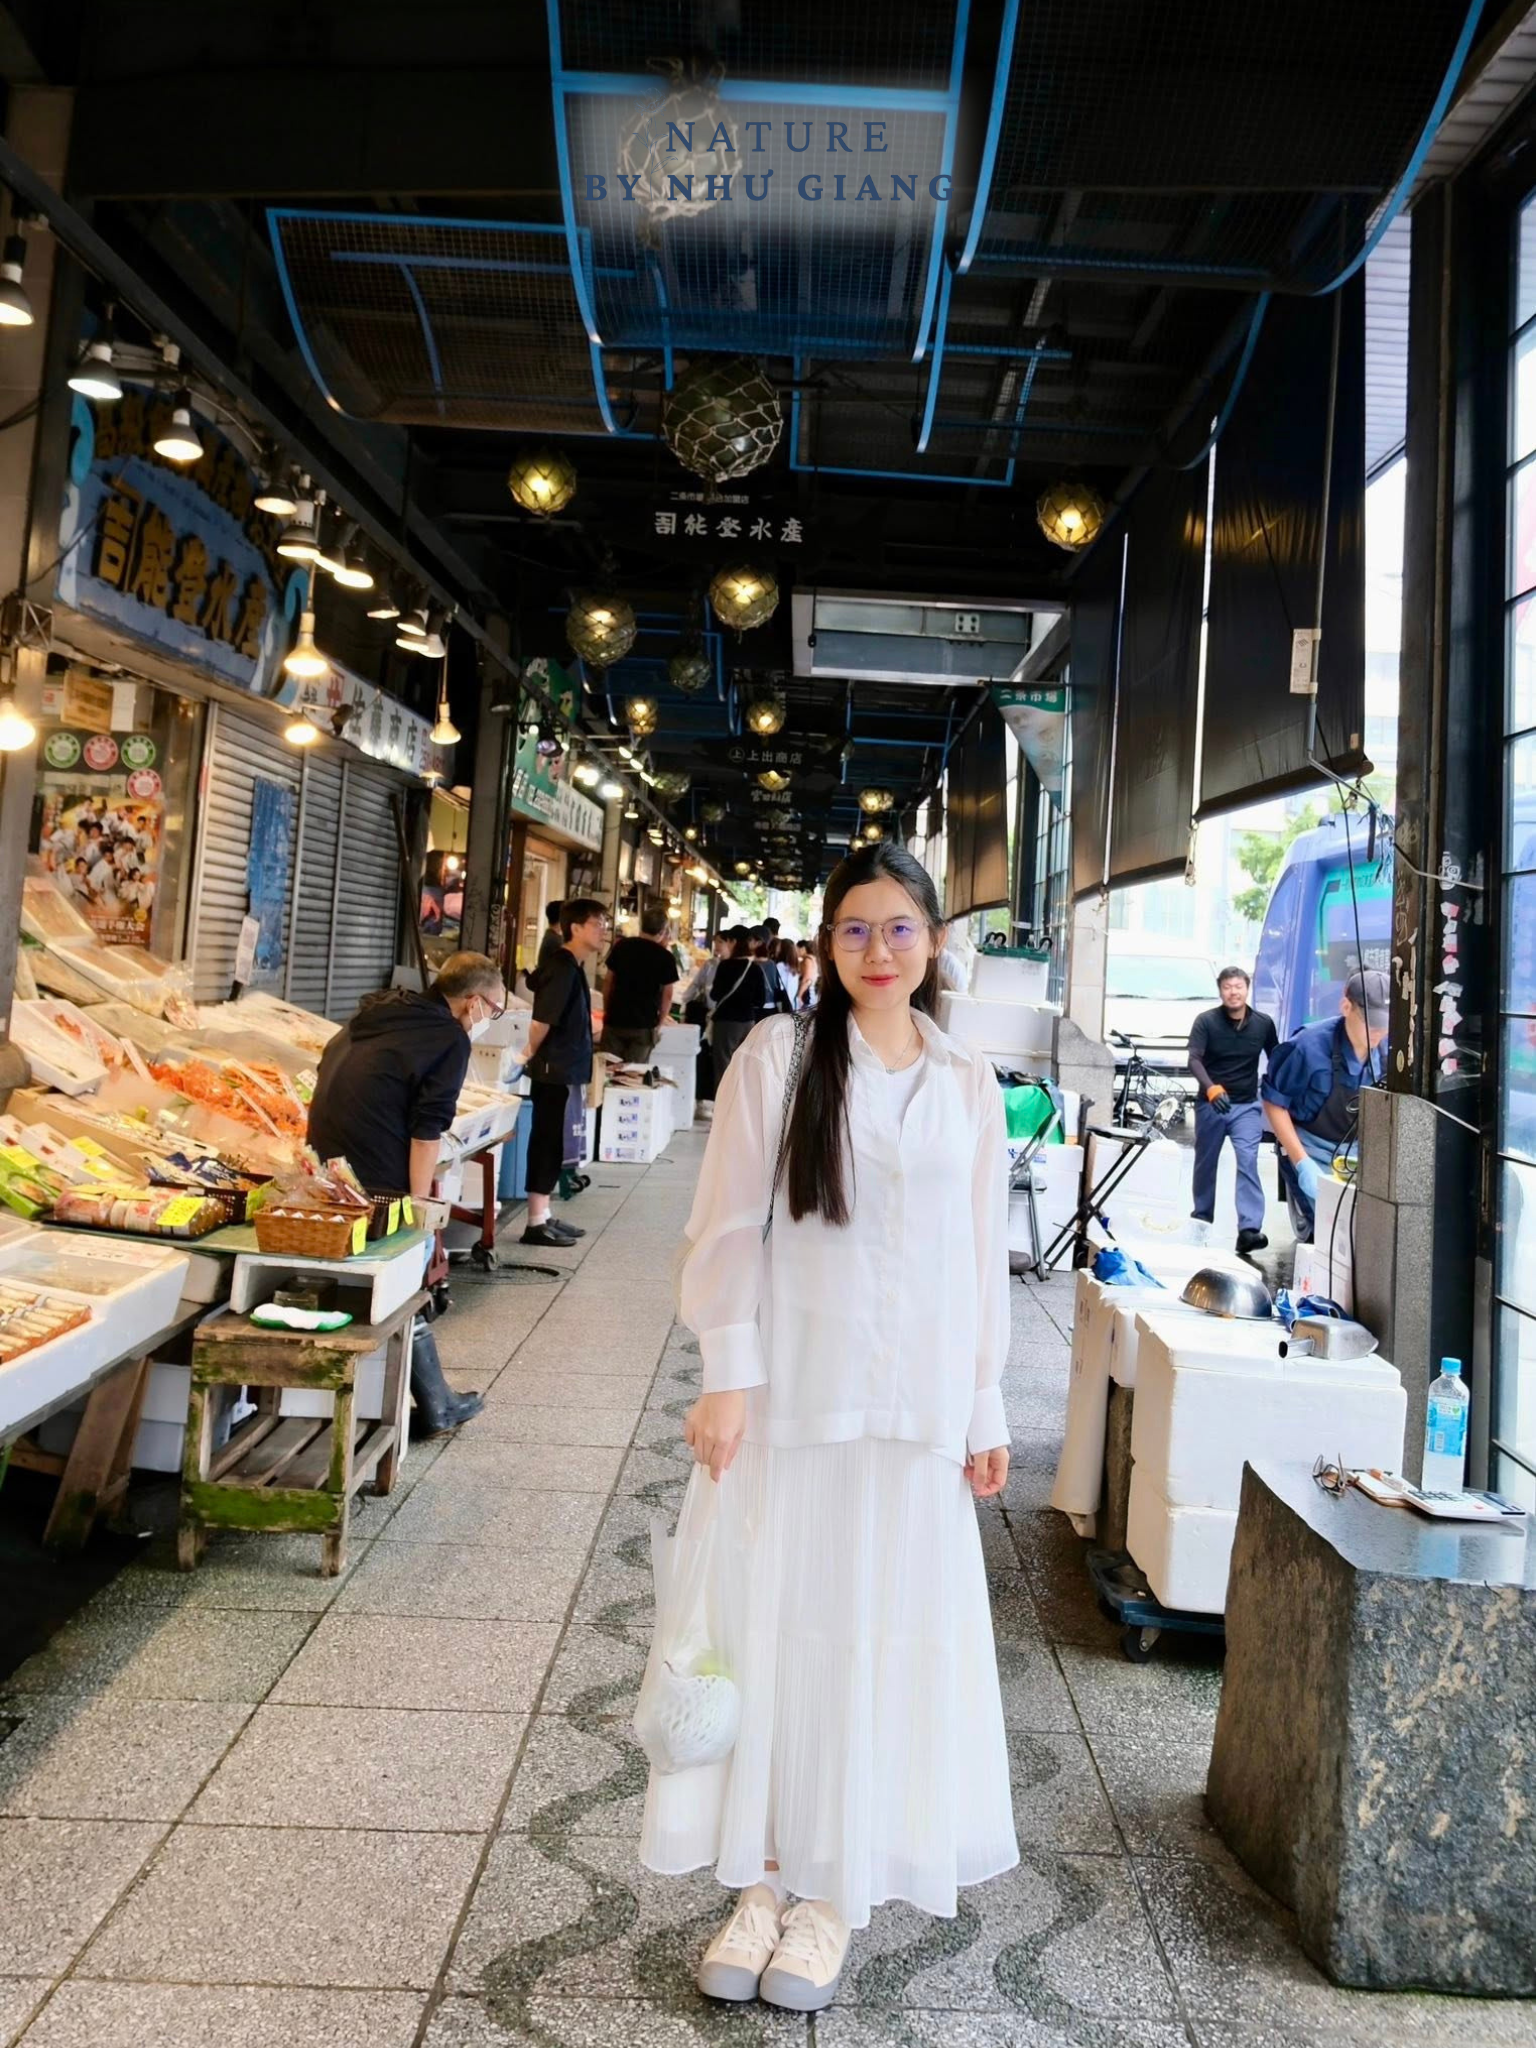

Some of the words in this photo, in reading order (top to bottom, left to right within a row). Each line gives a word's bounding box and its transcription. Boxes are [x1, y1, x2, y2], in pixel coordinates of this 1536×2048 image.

[999, 688, 1058, 704] 二条市場
[746, 750, 802, 765] 上出商店
